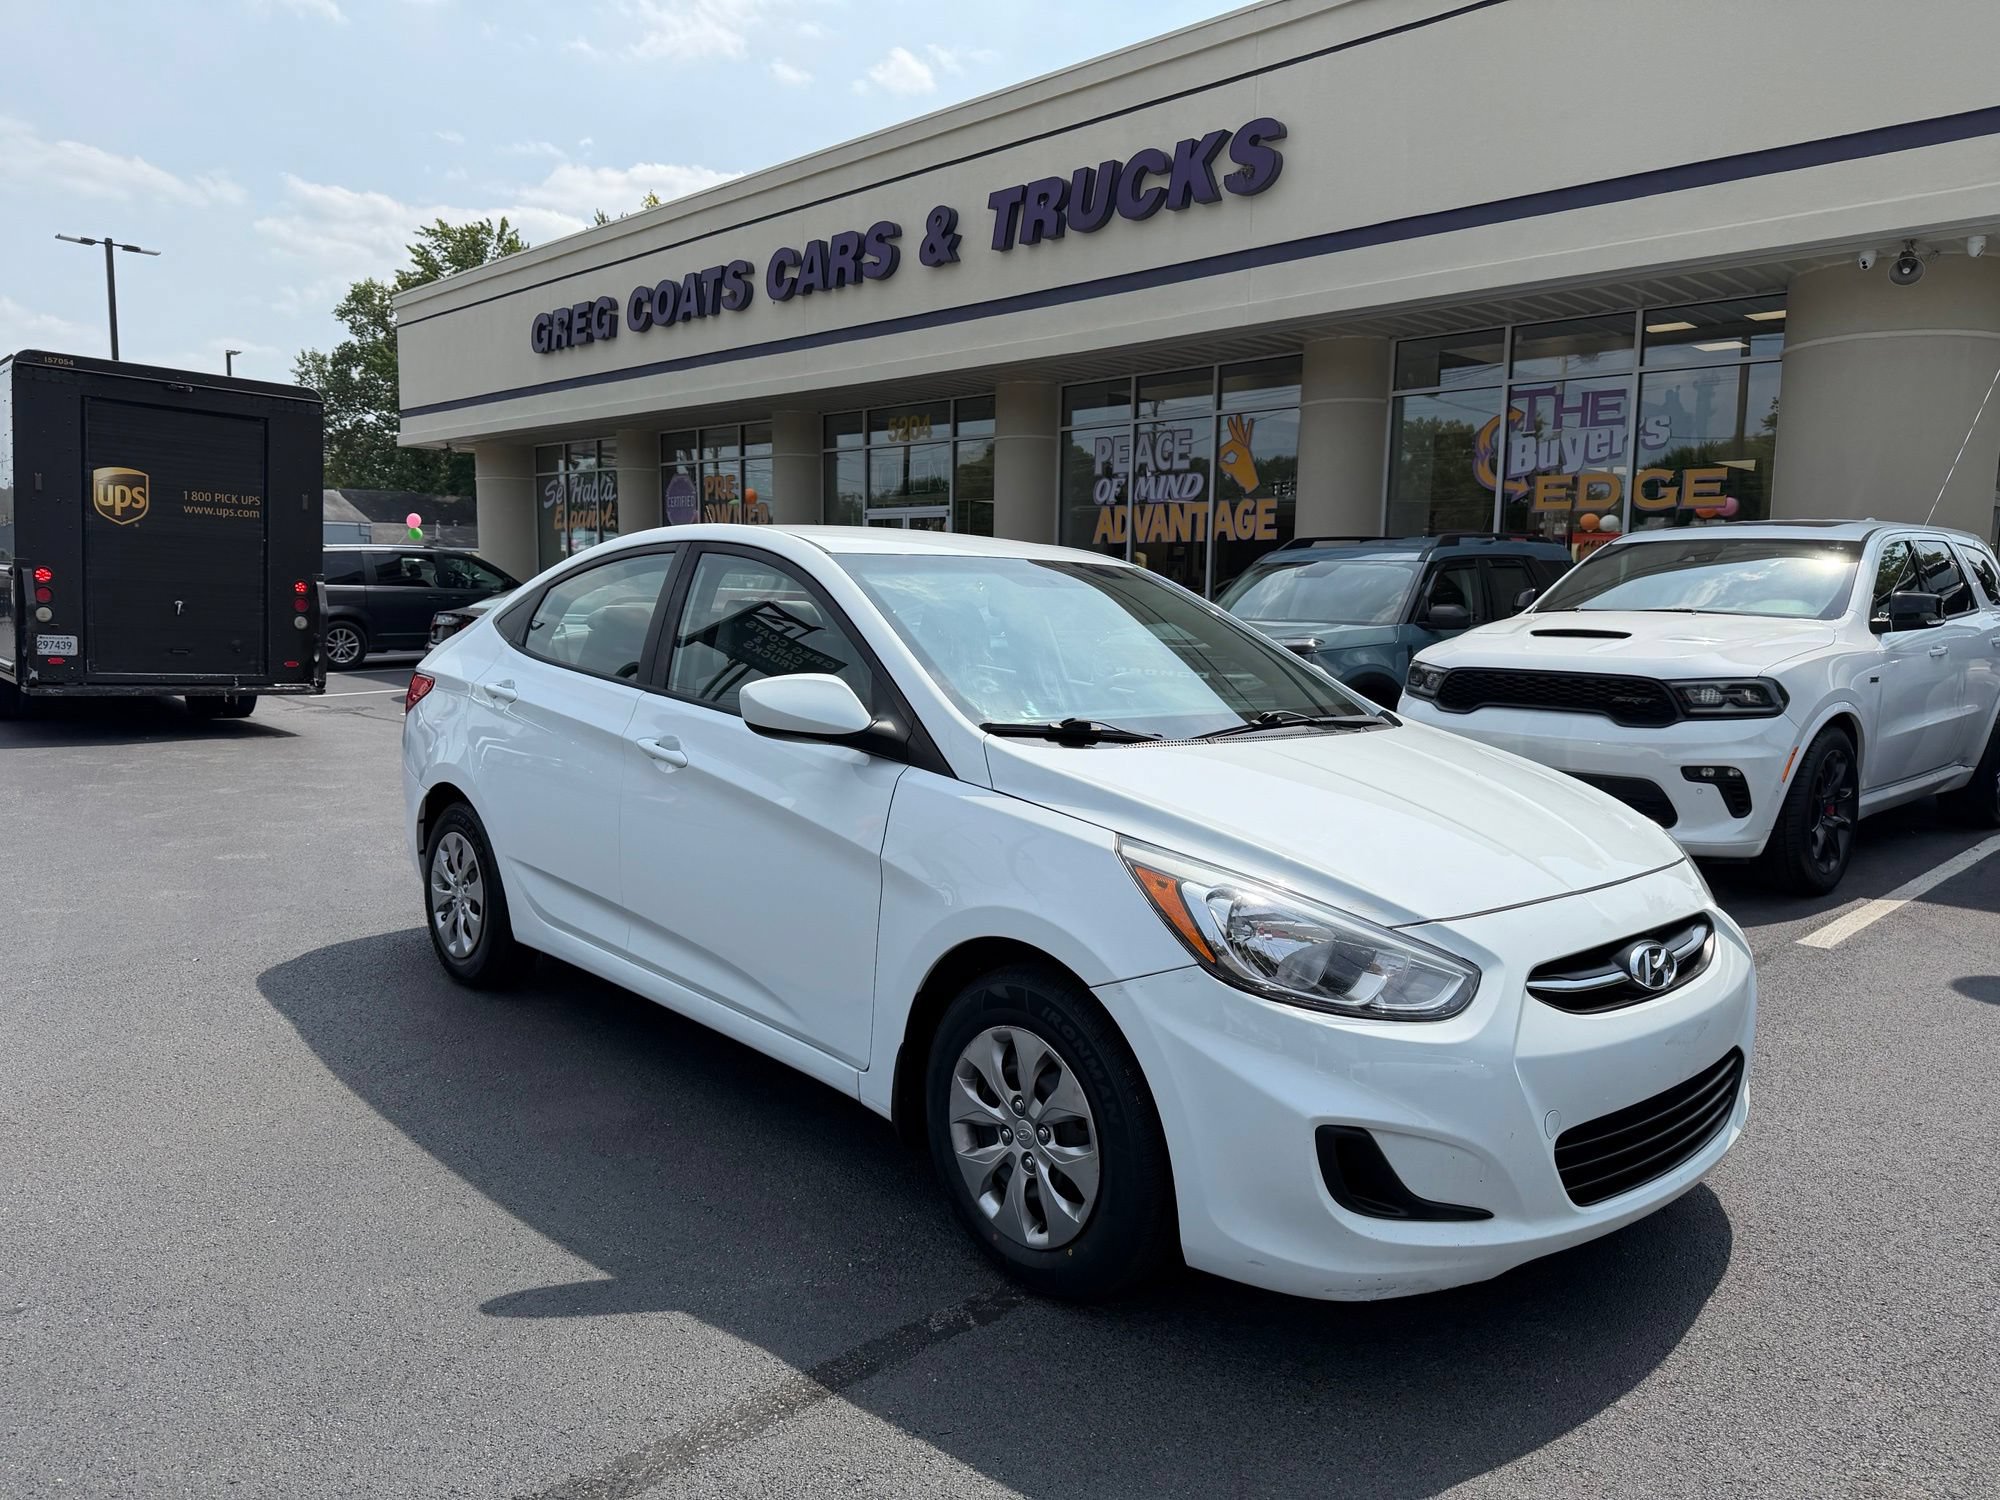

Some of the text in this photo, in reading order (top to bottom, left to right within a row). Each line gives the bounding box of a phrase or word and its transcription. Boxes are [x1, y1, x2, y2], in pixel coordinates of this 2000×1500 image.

[531, 117, 1288, 354] GREG COATS CARS & TRUCKS
[1510, 386, 1628, 435] THE
[887, 414, 933, 442] 5204
[1093, 428, 1193, 476] PEACE
[97, 484, 146, 517] ups
[183, 490, 261, 506] 1 800 PICK UPS
[543, 480, 565, 509] Se
[667, 495, 696, 508] CERTIFIED
[1093, 472, 1205, 505] OF MIND
[1532, 467, 1728, 513] EDGE
[183, 505, 260, 519] www.ups.com
[1092, 498, 1278, 545] ADVANTAGE
